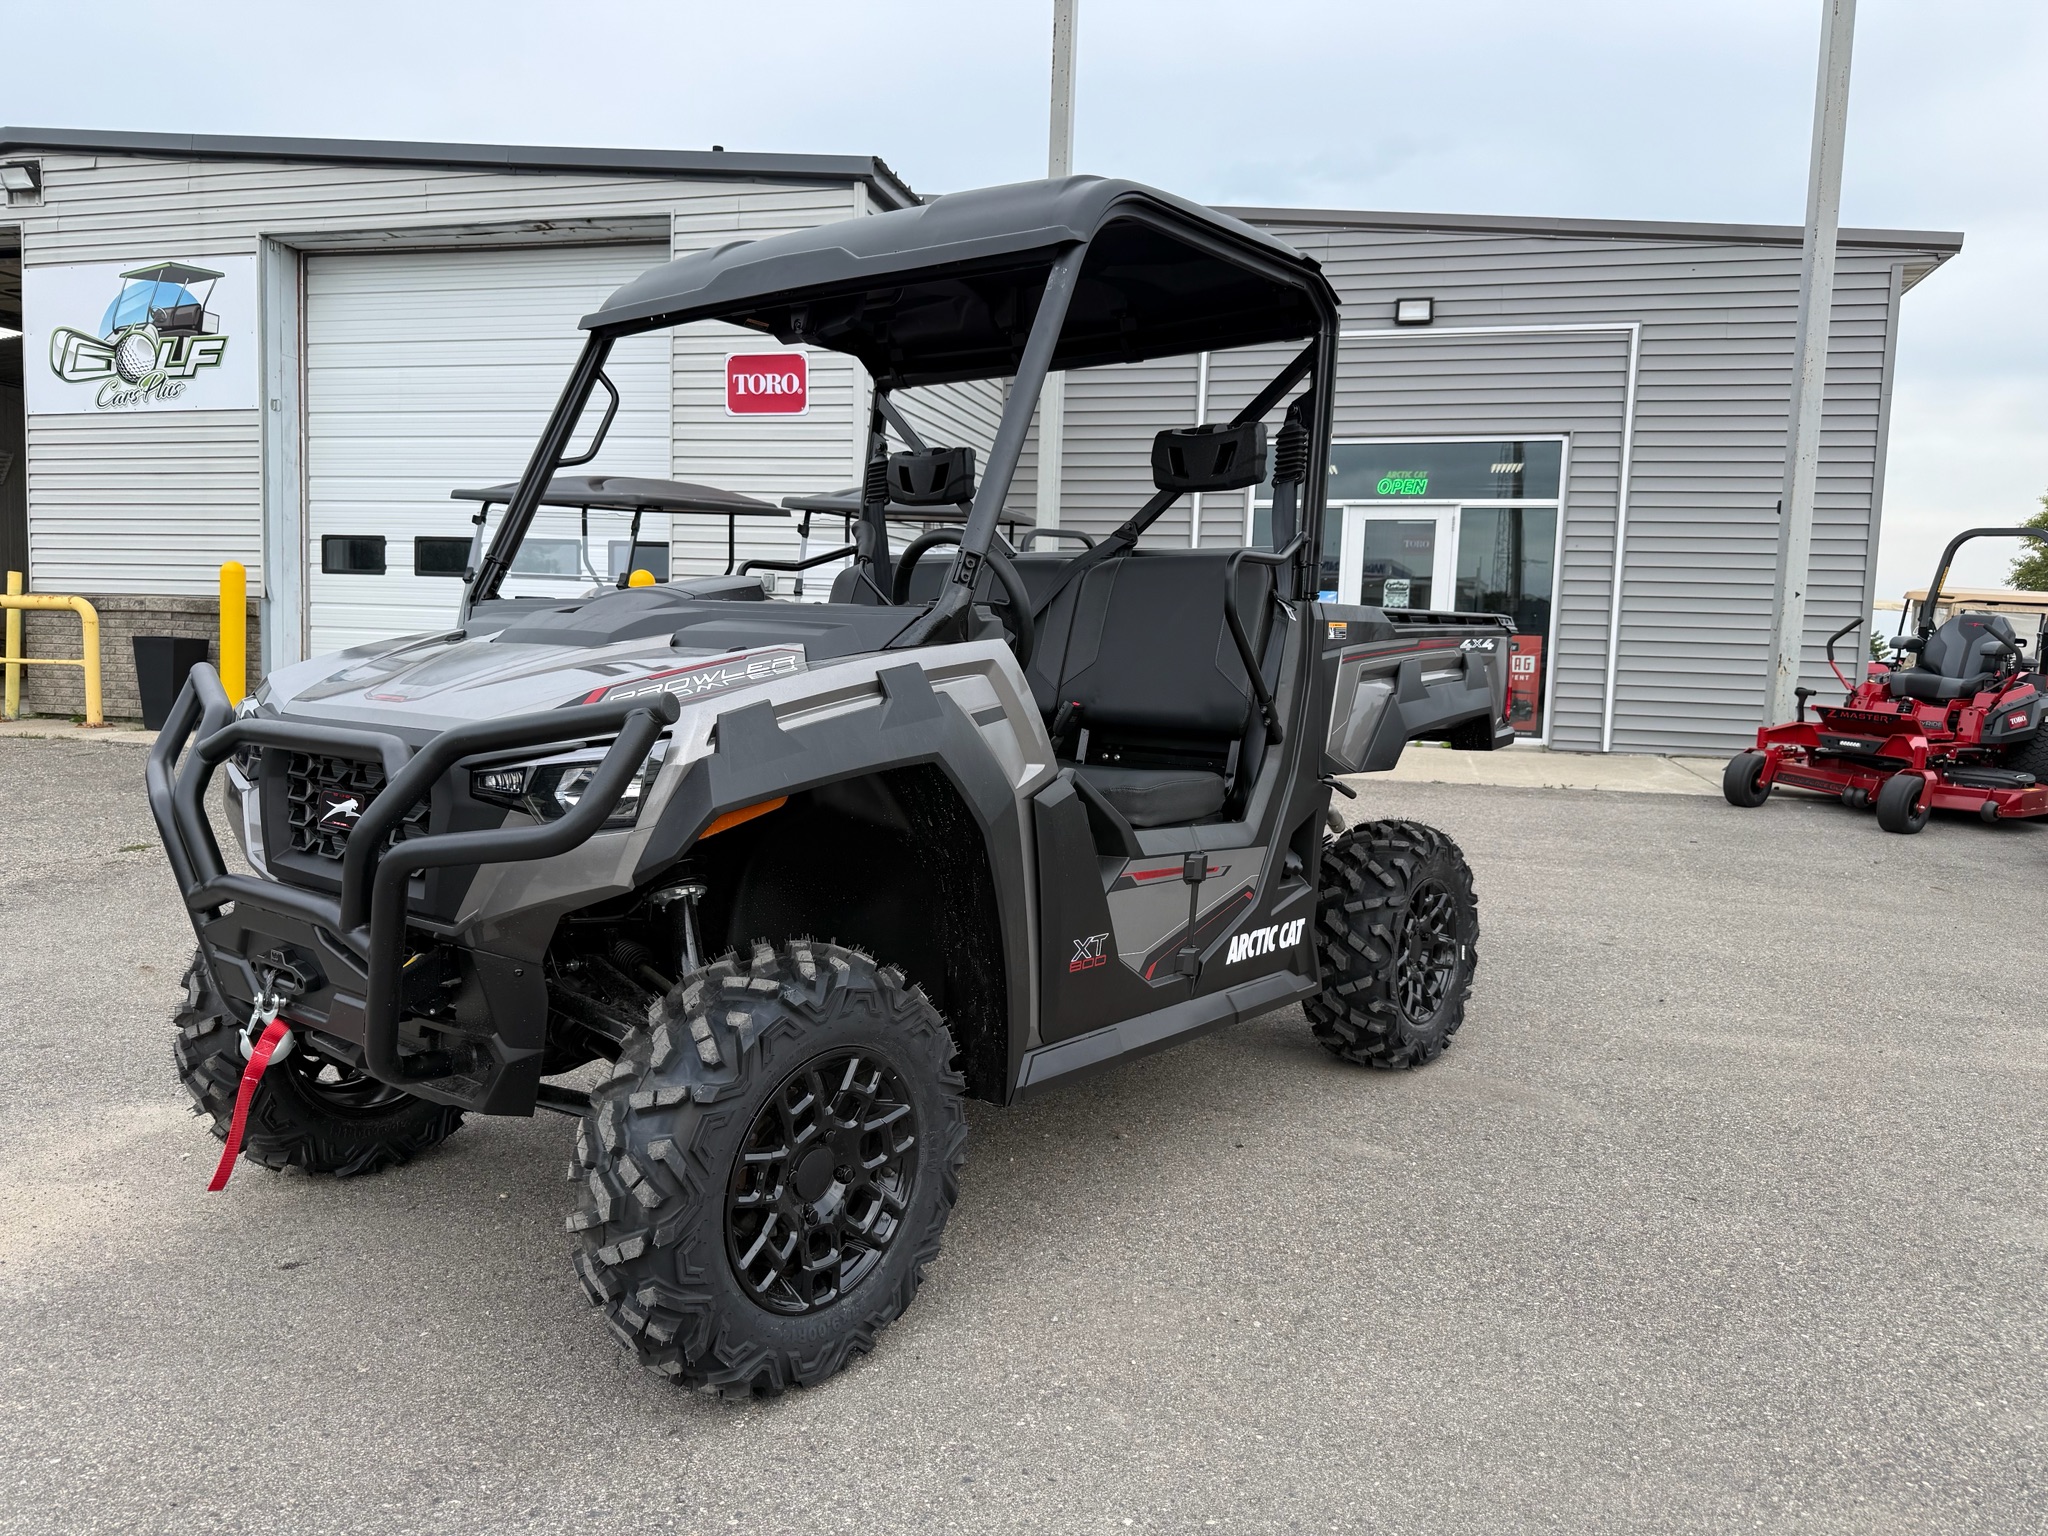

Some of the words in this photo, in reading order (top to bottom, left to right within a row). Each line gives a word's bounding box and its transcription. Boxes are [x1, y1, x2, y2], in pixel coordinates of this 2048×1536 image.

[97, 379, 142, 409] Cars
[138, 371, 186, 403] Plus
[732, 373, 800, 395] TORO
[1386, 470, 1412, 479] ARCTIC
[1413, 470, 1429, 479] CAT
[1377, 478, 1428, 495] OPEN
[1512, 657, 1531, 671] AG
[609, 654, 797, 702] PROWLER
[1827, 709, 1838, 718] Z
[1840, 711, 1889, 724] MASTER
[2010, 715, 2027, 725] TORO
[1070, 932, 1110, 963] XT
[1225, 923, 1279, 966] ARCTIC
[1278, 917, 1306, 953] CAT
[1069, 954, 1107, 973] 800
